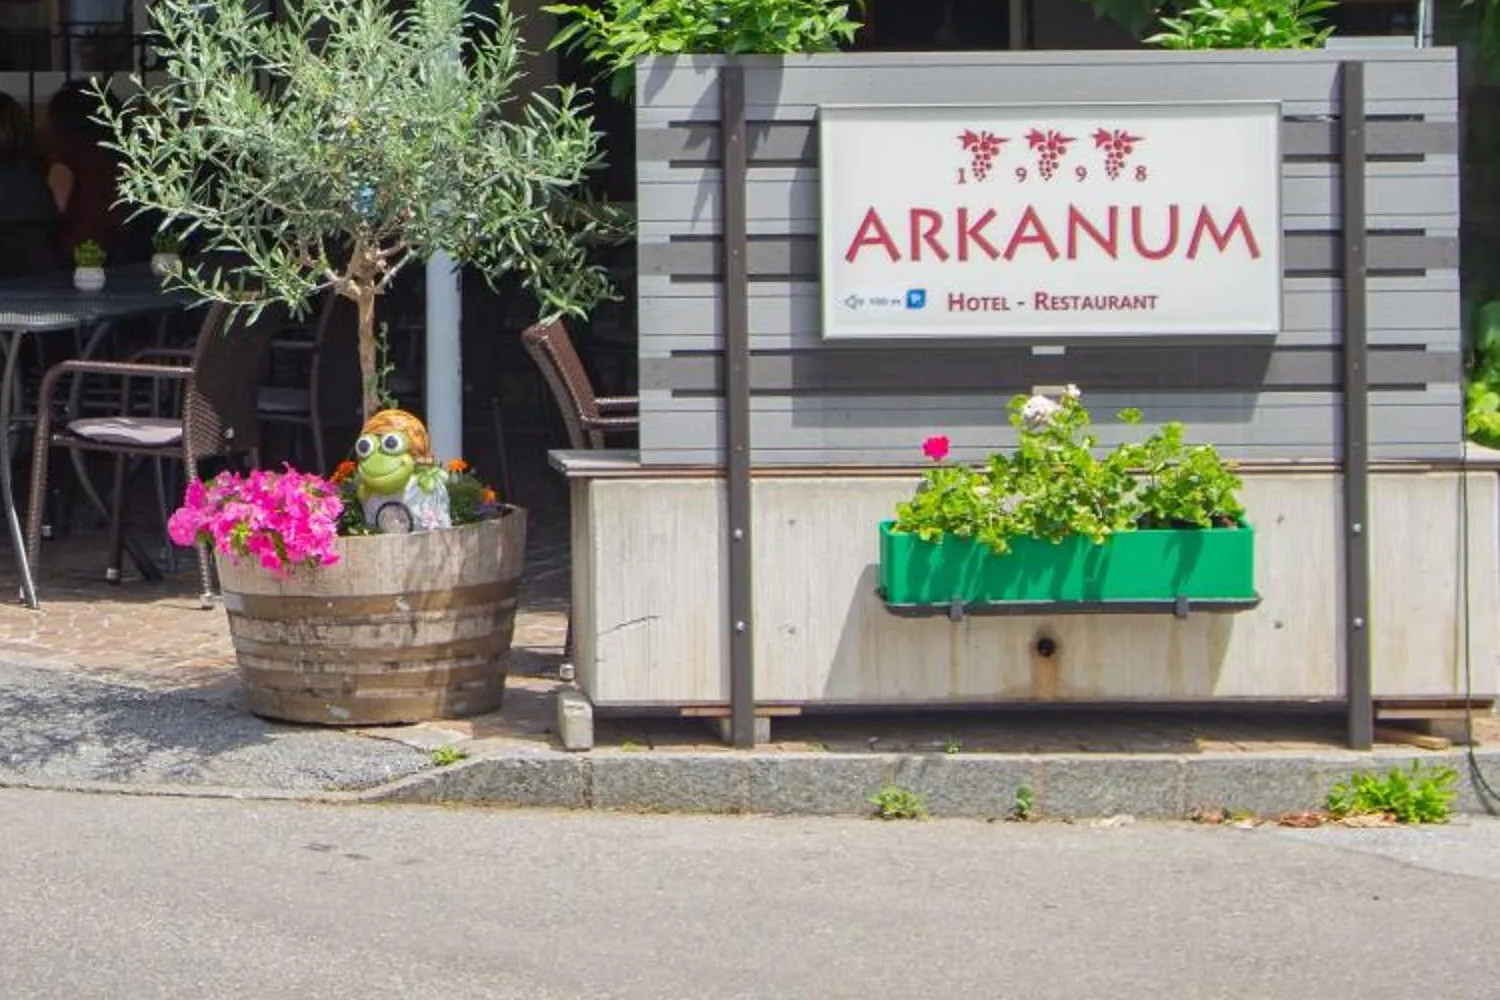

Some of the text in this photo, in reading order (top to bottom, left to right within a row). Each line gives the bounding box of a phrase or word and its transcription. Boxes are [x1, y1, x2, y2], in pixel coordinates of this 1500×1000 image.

[844, 204, 1262, 262] ARKANUM
[948, 293, 1011, 312] HOTEL
[1034, 291, 1159, 311] RESTAURANT
